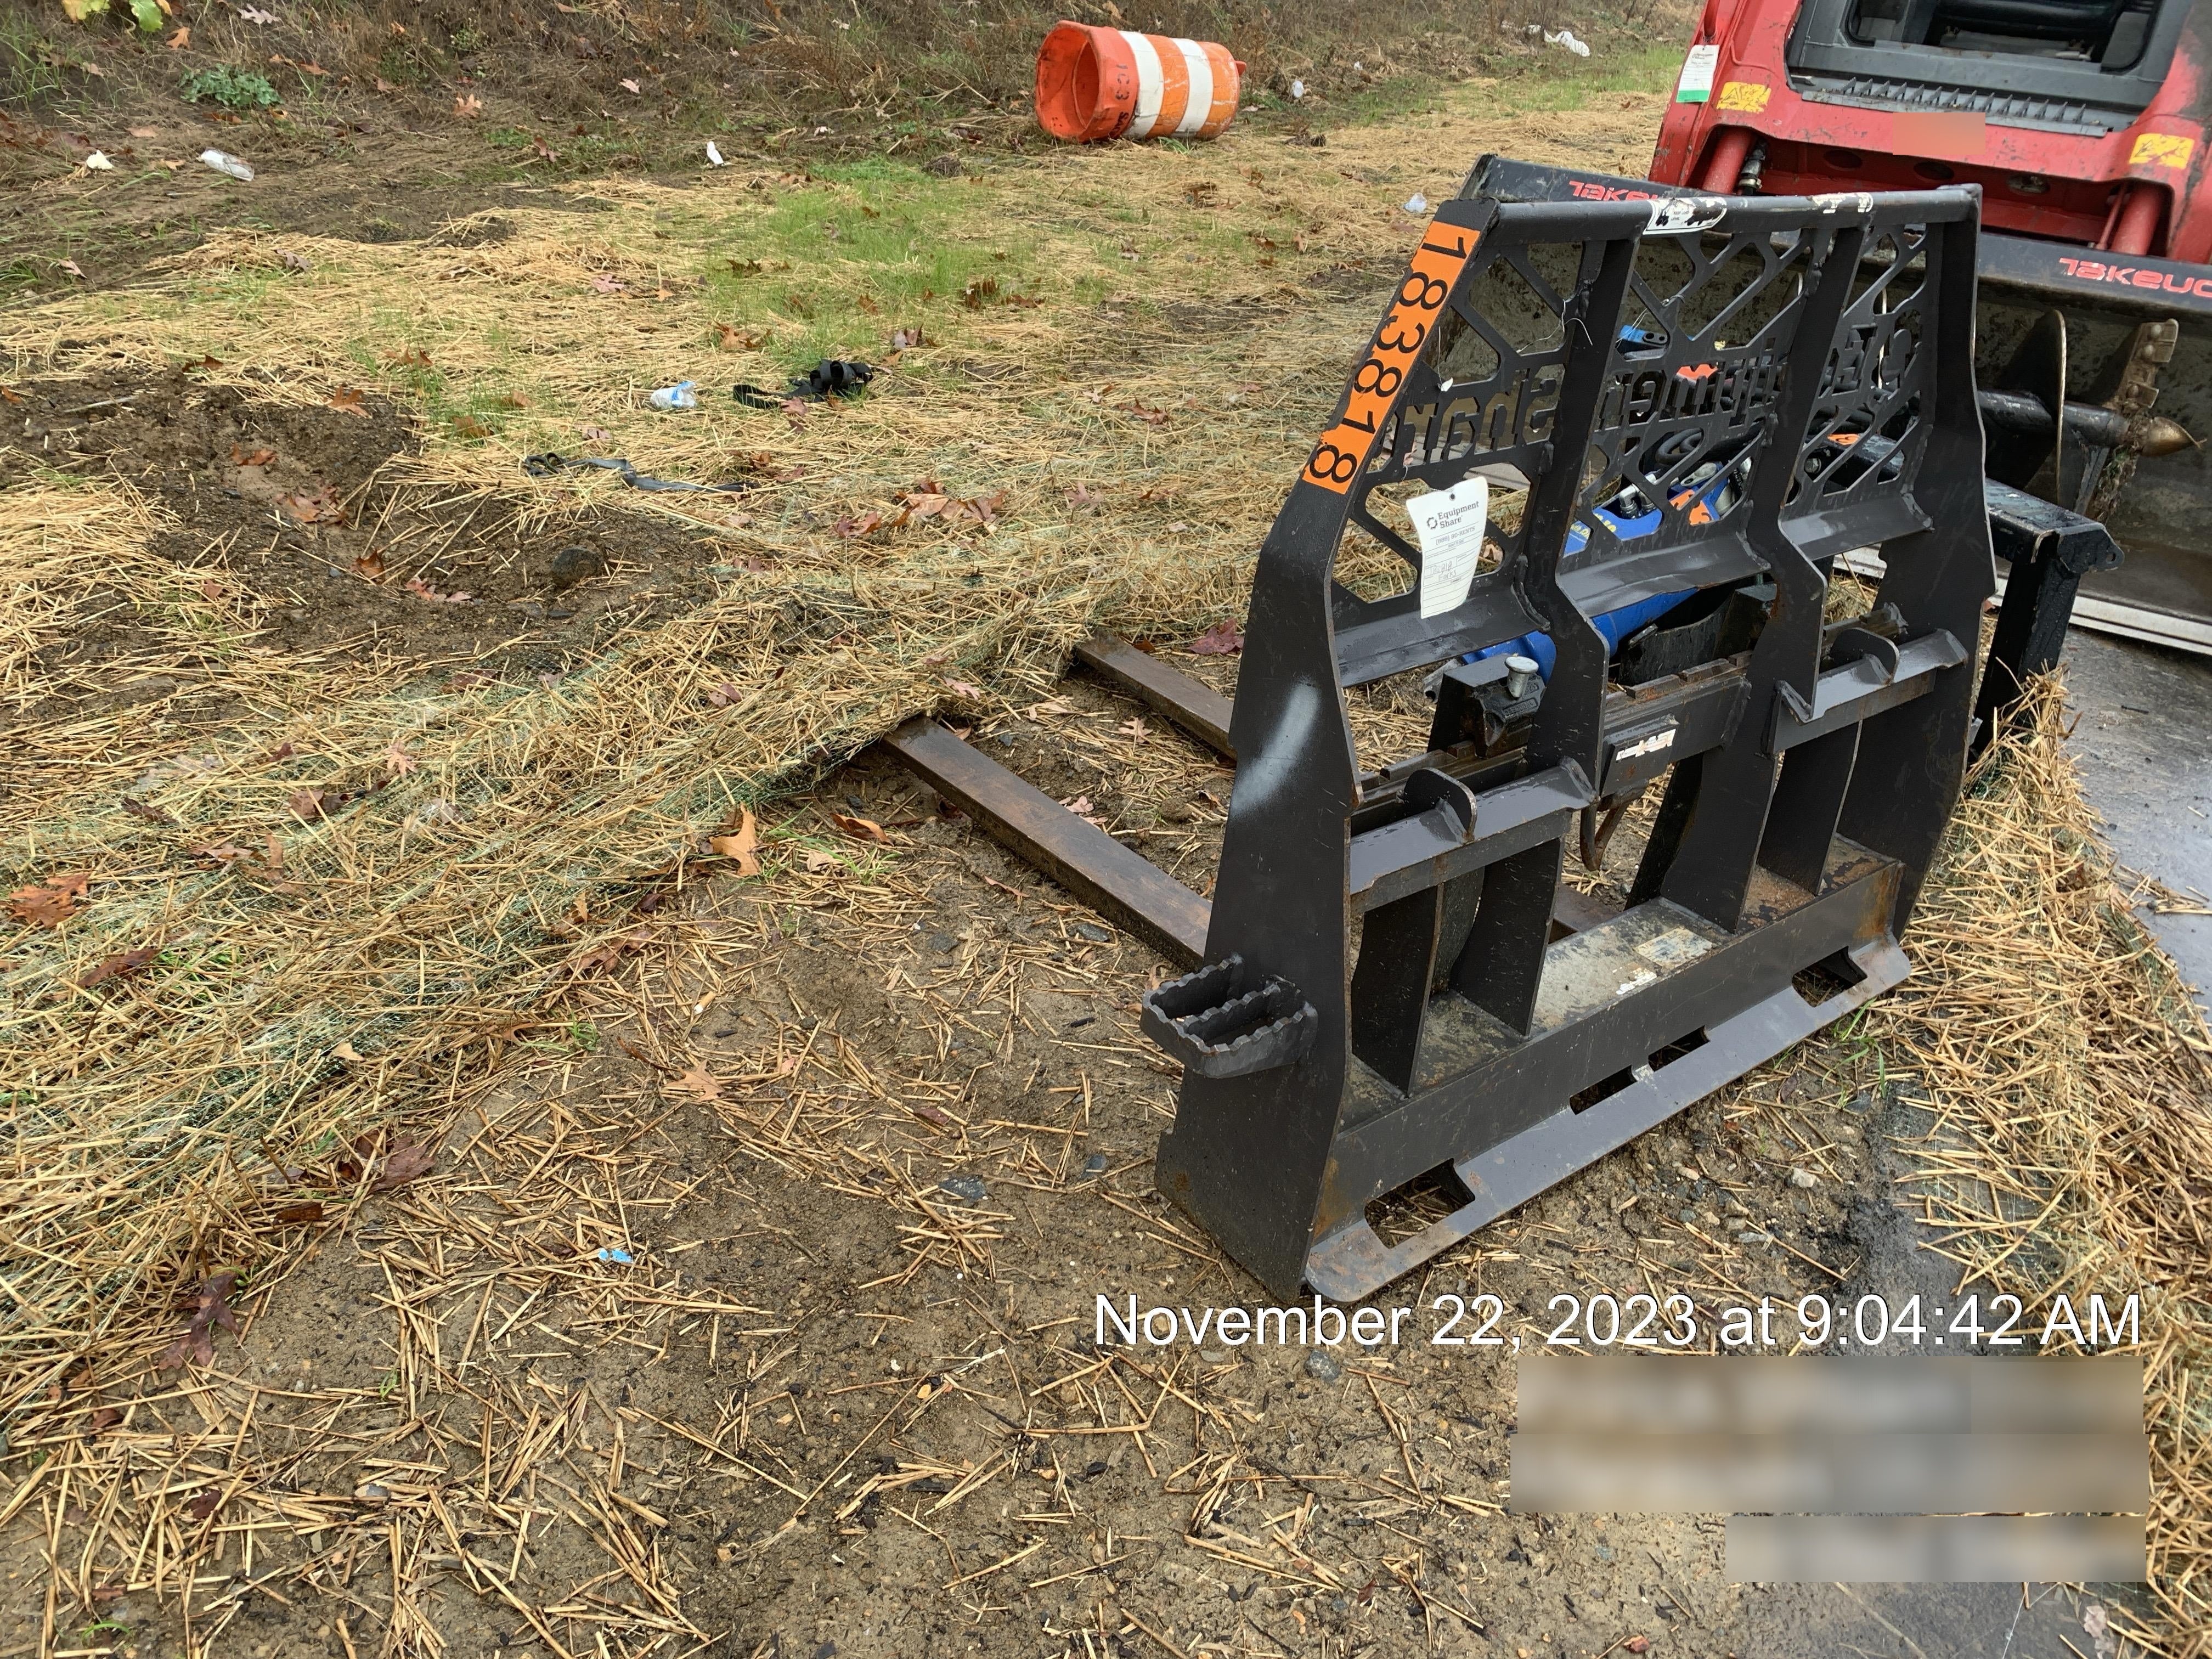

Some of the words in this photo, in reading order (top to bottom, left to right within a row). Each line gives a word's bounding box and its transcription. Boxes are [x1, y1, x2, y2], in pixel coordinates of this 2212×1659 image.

[1310, 236, 1467, 483] 183818
[1437, 500, 1480, 520] Equipment
[1439, 517, 1462, 529] Share
